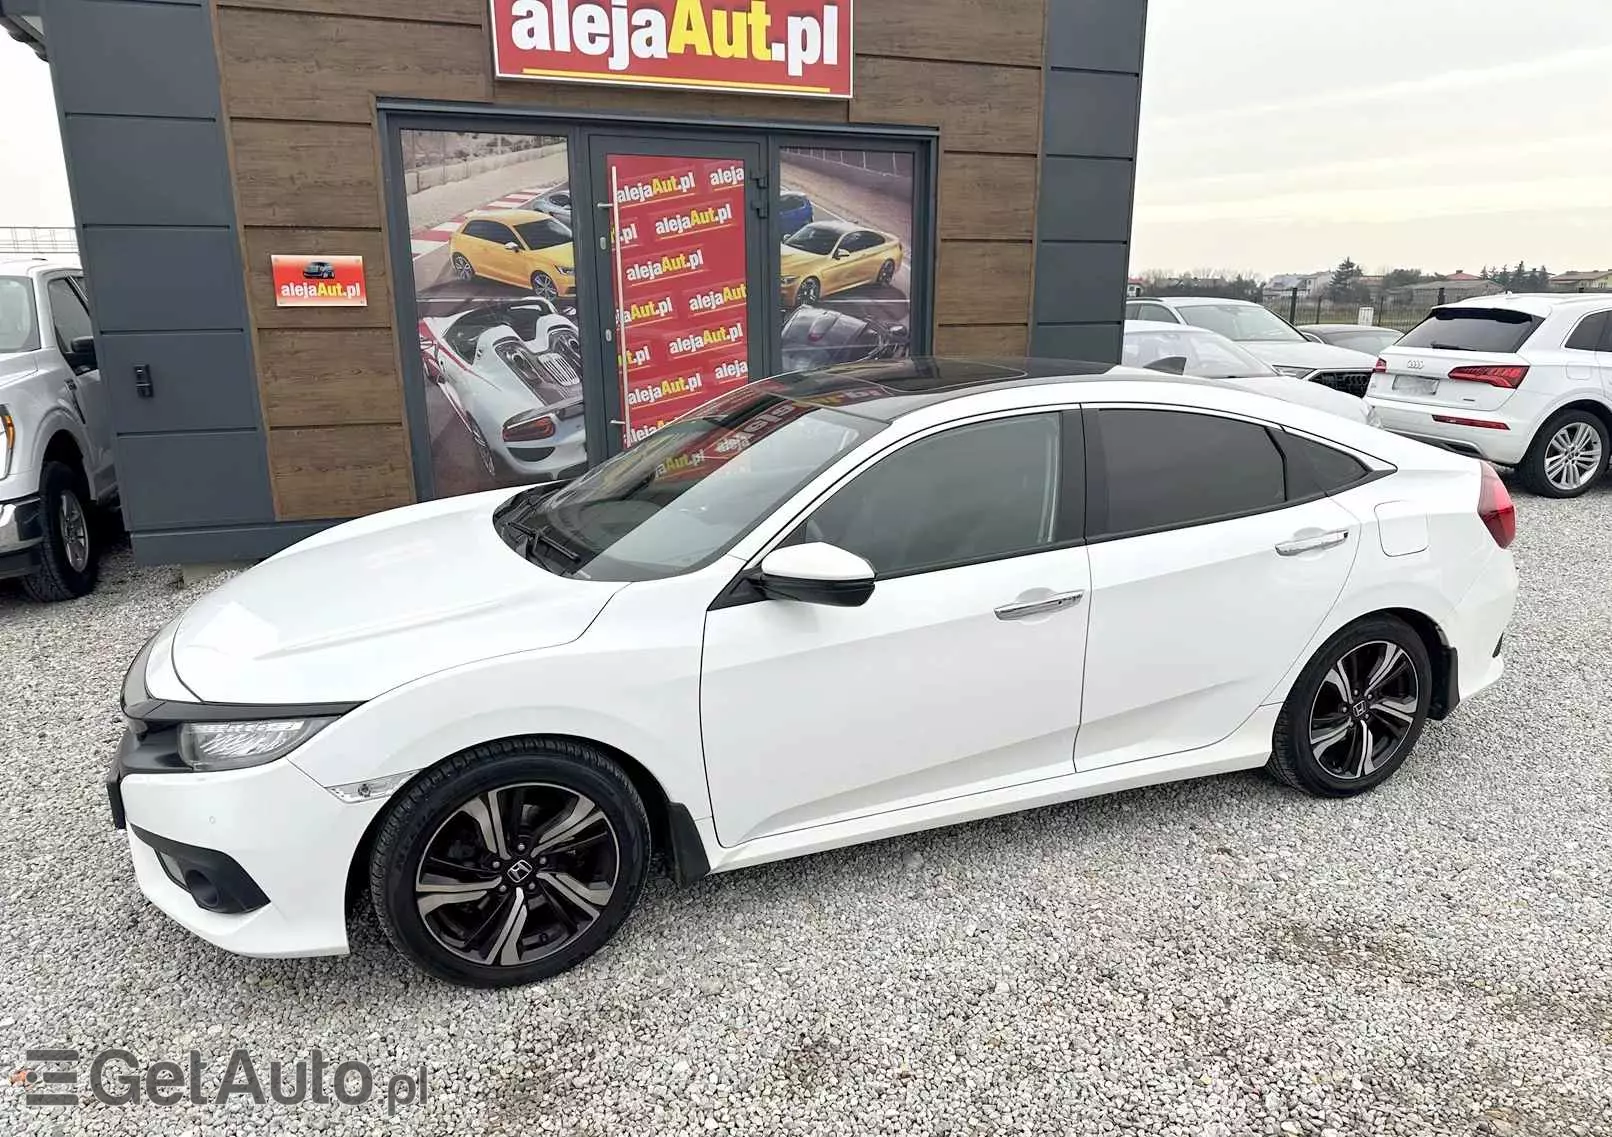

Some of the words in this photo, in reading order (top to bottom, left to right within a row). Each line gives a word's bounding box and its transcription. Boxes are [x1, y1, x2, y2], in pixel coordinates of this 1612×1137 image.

[511, 0, 838, 76] alejaAut.pl
[617, 172, 696, 203] alejaAut.pl
[710, 166, 744, 186] aleja
[655, 203, 732, 235] alejaAut.pl
[626, 249, 704, 281] alejaAut.pl
[281, 282, 360, 299] alejaAut.pl
[669, 323, 743, 354] alejaAut.pl
[628, 373, 702, 405] alejaAut.pl
